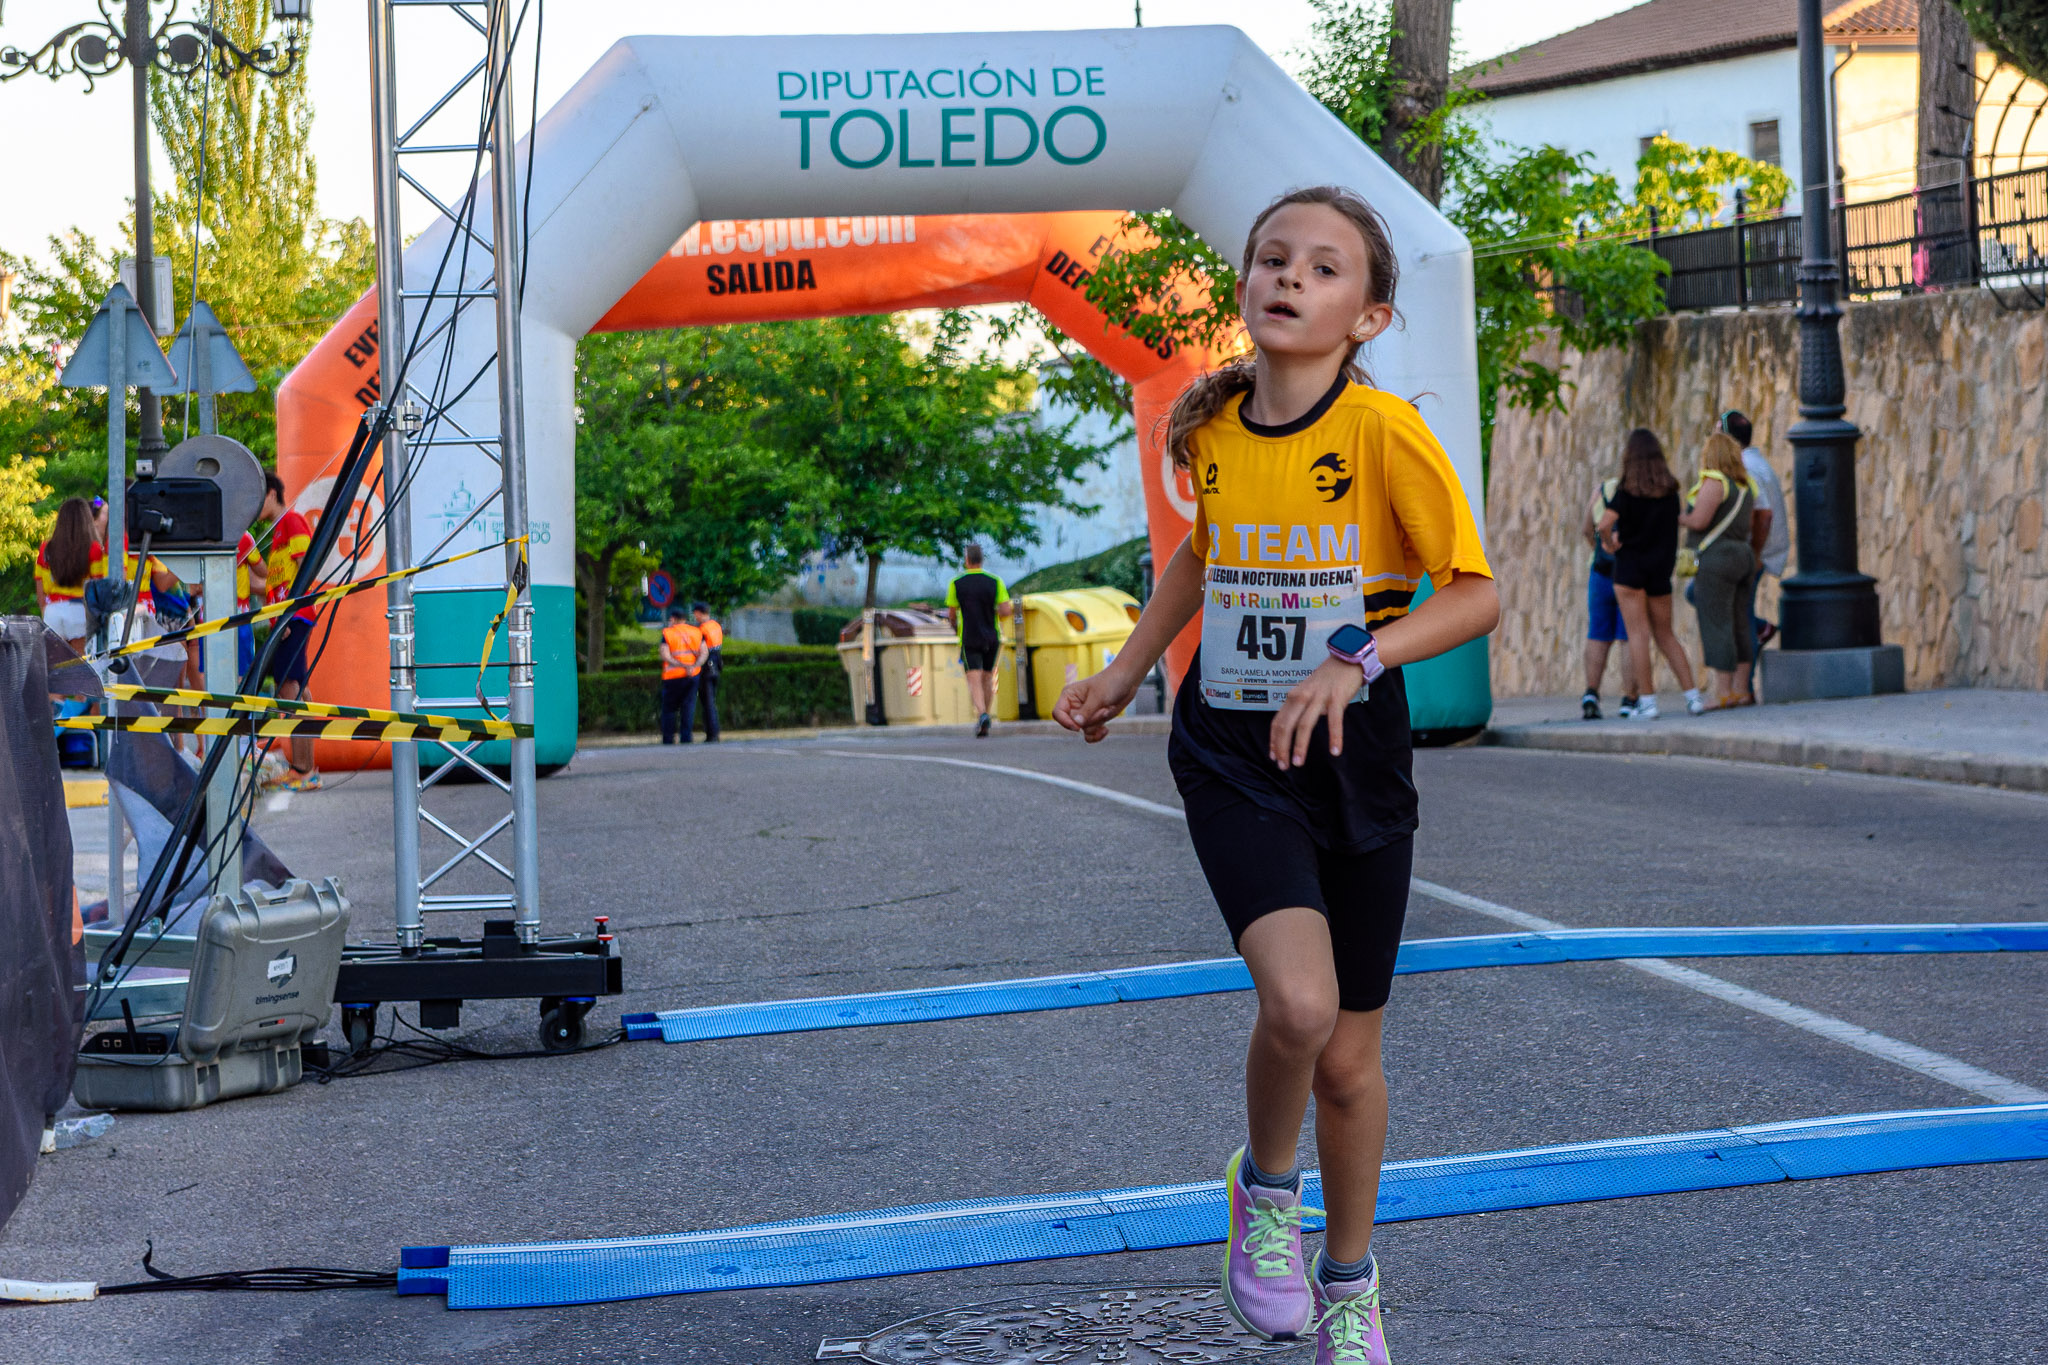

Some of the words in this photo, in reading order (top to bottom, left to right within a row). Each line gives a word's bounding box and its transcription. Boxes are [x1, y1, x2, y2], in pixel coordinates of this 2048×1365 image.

[778, 61, 1036, 100] DIPUTACIÓN
[1052, 67, 1106, 96] DE
[780, 105, 1108, 170] TOLEDO
[706, 259, 817, 295] SALIDA
[1233, 524, 1360, 562] TEAM
[1212, 568, 1239, 585] LEGUA
[1241, 570, 1307, 588] NOCTURNA
[1309, 569, 1353, 587] UGENA
[1236, 614, 1307, 662] 457
[1221, 666, 1240, 676] SARA
[1240, 668, 1271, 677] LAMELA
